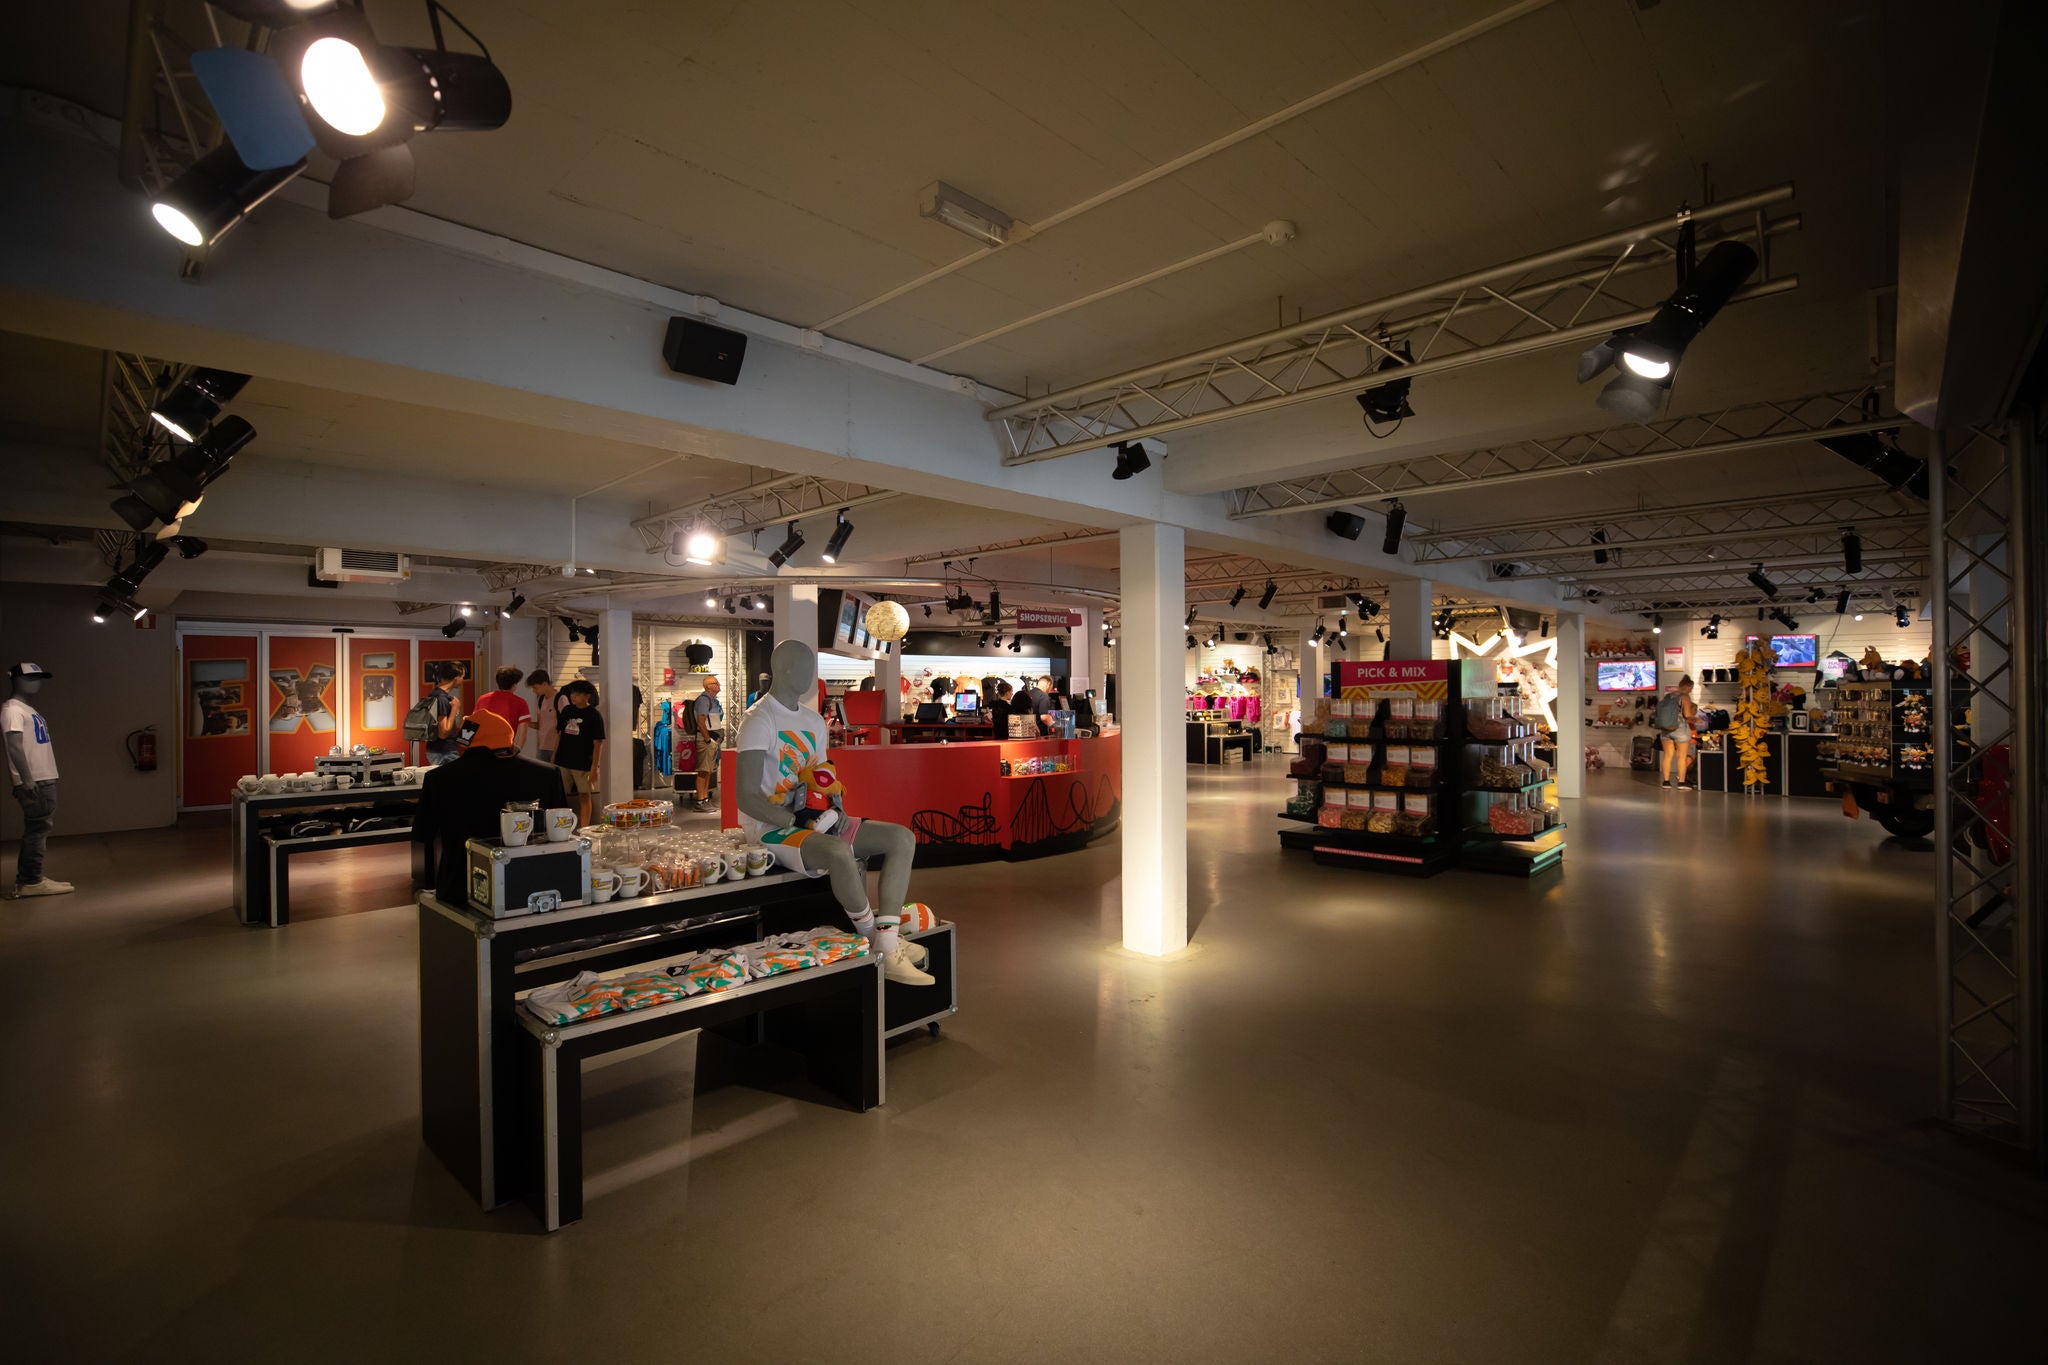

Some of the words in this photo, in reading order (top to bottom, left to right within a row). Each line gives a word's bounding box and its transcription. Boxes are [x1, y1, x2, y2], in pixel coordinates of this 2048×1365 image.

[1357, 667, 1386, 678] PICK
[1388, 666, 1398, 678] &
[1401, 666, 1427, 678] MIX
